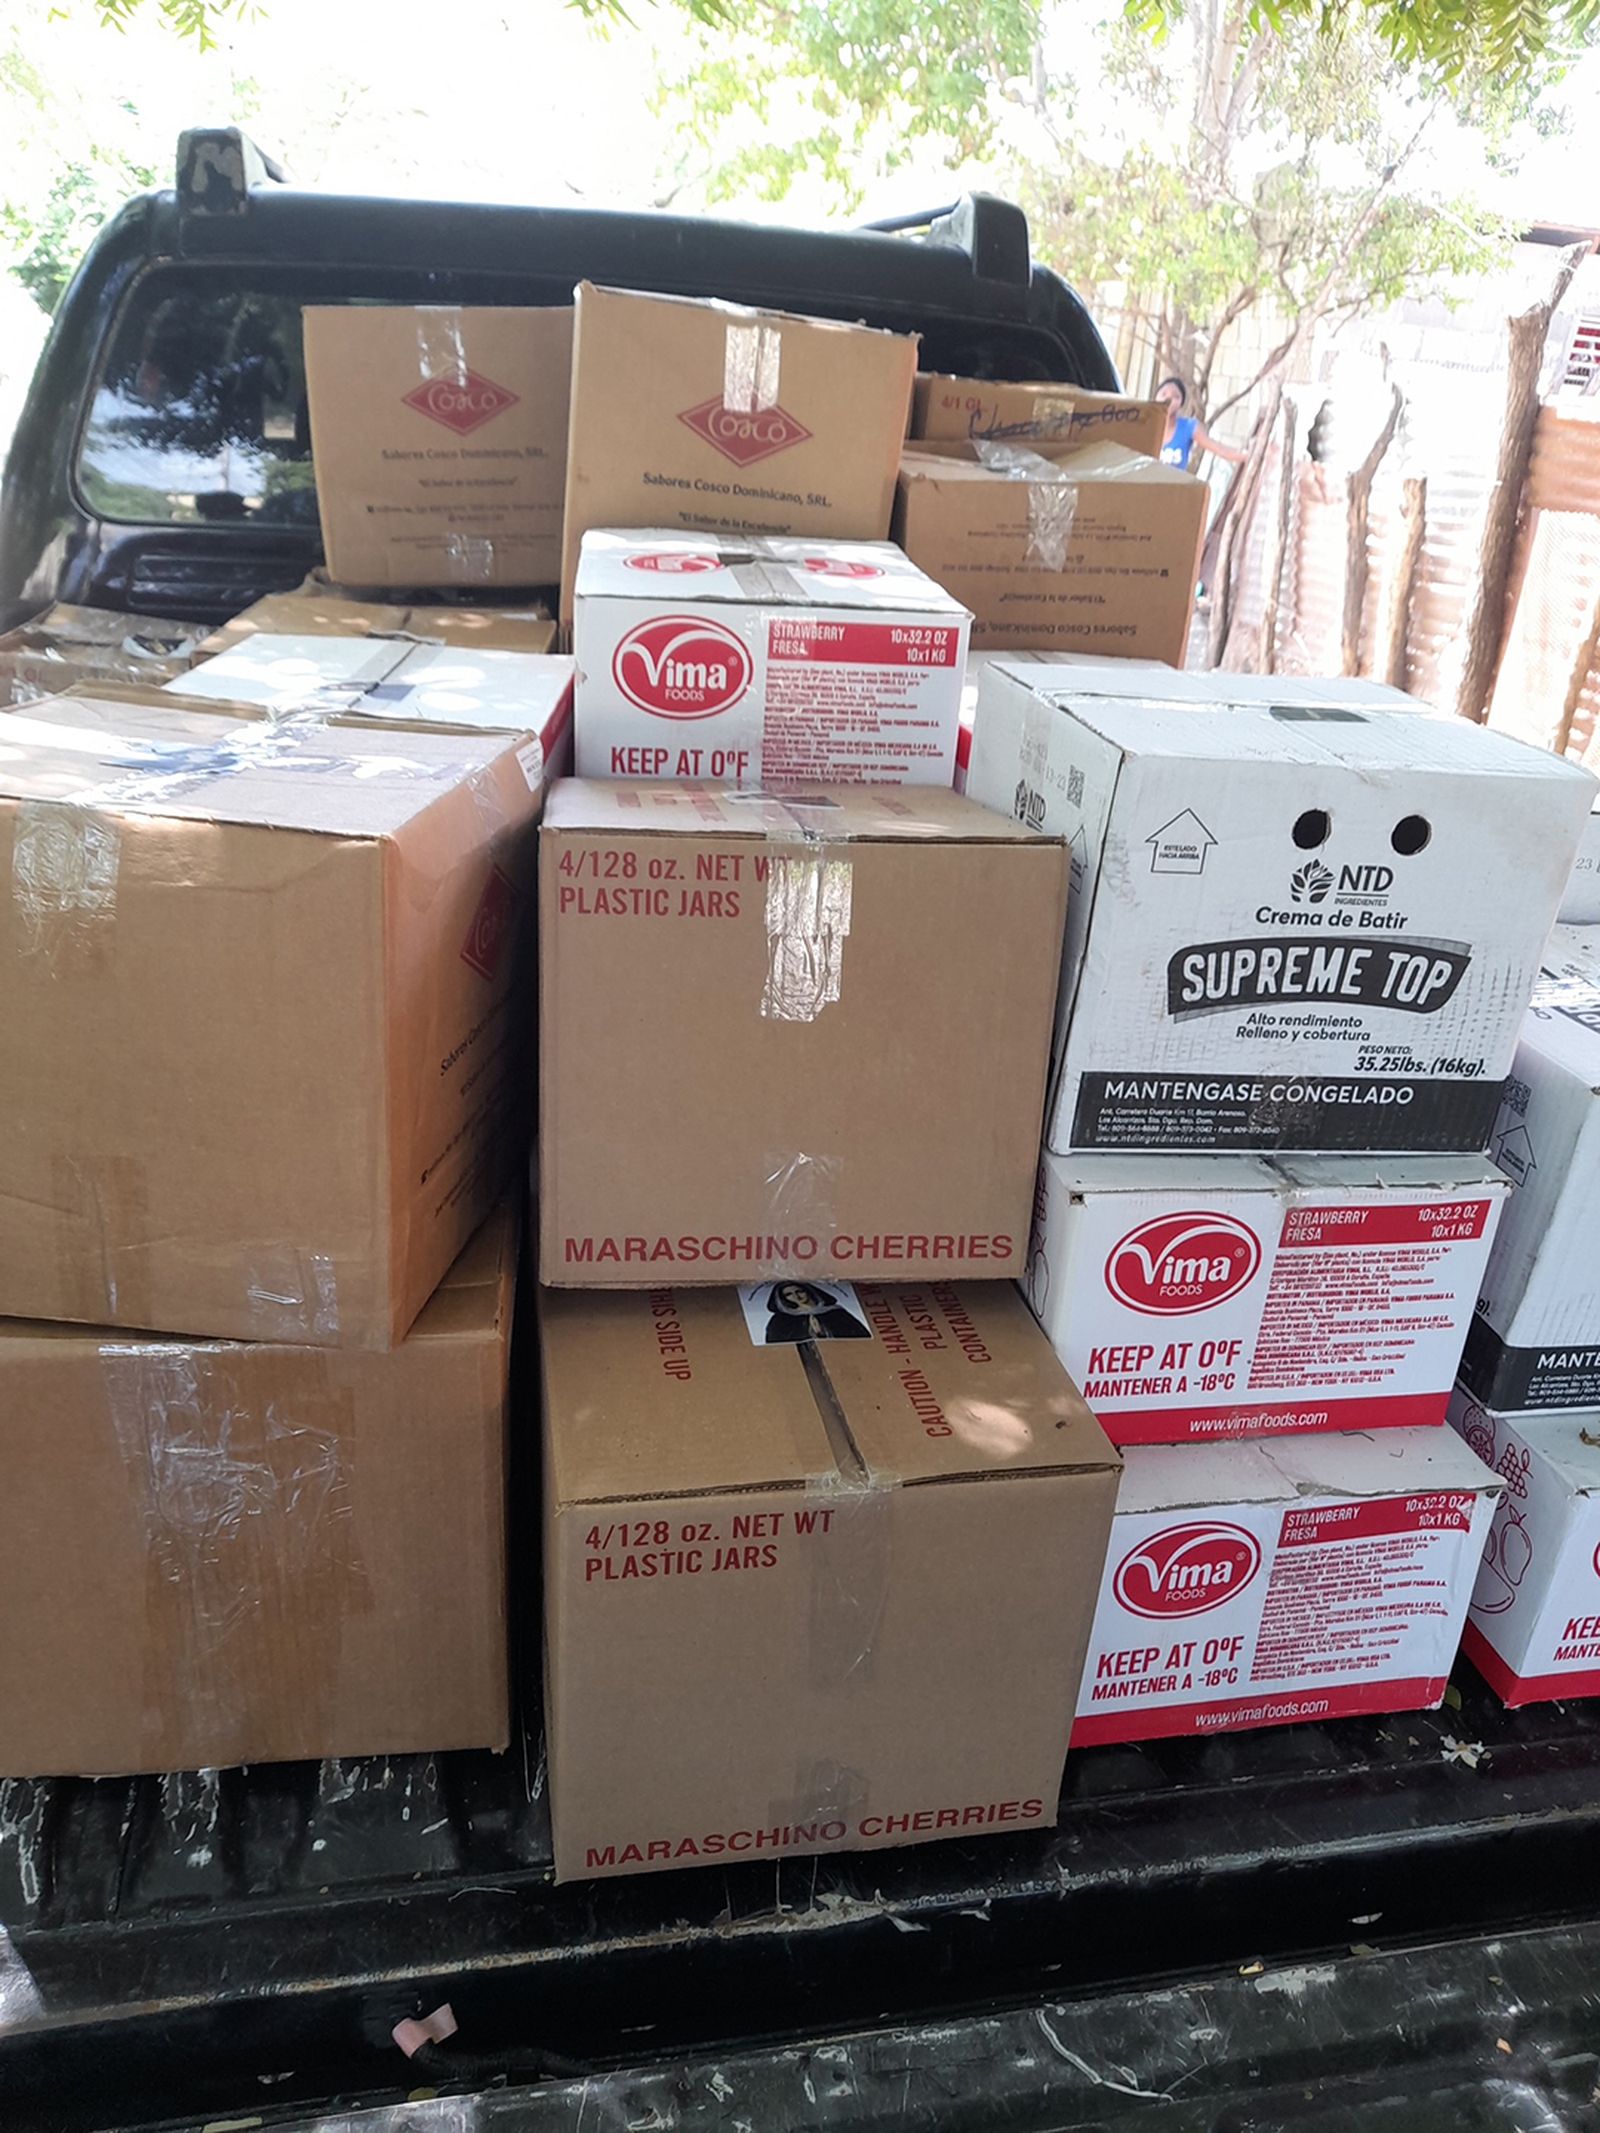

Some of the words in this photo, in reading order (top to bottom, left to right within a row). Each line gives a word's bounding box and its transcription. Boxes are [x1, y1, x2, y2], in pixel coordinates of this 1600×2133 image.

[643, 471, 691, 489] Sabores
[694, 478, 731, 495] Cosco
[733, 484, 804, 505] Dominicano,
[807, 493, 832, 508] SRL.
[773, 625, 845, 641] STRAWBERRY
[891, 629, 931, 645] 10x32.2
[933, 630, 948, 645] OZ
[624, 627, 727, 690] Vima
[773, 640, 808, 655] FRESA
[906, 648, 930, 662] 10x1
[932, 649, 946, 663] KG
[665, 688, 705, 702] FOODS
[611, 747, 668, 775] KEEP
[677, 749, 703, 776] AT
[559, 850, 638, 880] 4/128
[648, 858, 686, 881] oz.
[696, 853, 745, 882] NET
[1338, 864, 1394, 892] NTD
[559, 886, 669, 917] PLASTIC
[677, 890, 740, 918] JARS
[1255, 906, 1323, 928] Crema
[1327, 907, 1354, 928] de
[1359, 911, 1409, 931] Batir
[1181, 946, 1374, 1003] SUPREME
[1381, 951, 1454, 1006] TOP
[1236, 1026, 1289, 1040] Relleno
[1291, 1030, 1300, 1042] y
[1302, 1027, 1371, 1042] cobertura
[1246, 1013, 1276, 1028] Alto
[1278, 1014, 1363, 1029] rendimiento
[1358, 1045, 1381, 1055] PESO
[1353, 1056, 1427, 1075] 35.25lbs.
[1430, 1056, 1486, 1077] (16kg).
[1104, 1081, 1263, 1102] MANTENGASE
[1269, 1084, 1414, 1106] CONGELADO
[1289, 1210, 1369, 1227] STRAWBERRY
[1417, 1207, 1461, 1223] 10x32.2
[1463, 1205, 1479, 1220] OZ
[1286, 1226, 1322, 1242] FRESA
[1431, 1223, 1457, 1239] 10x1
[1457, 1222, 1474, 1238] KG
[564, 1236, 819, 1263] MARASCHINO
[829, 1234, 1014, 1260] CHERRIES
[1119, 1224, 1230, 1286] Vima
[1159, 1283, 1203, 1298] FOODS
[864, 1299, 912, 1354] HANDLE
[899, 1294, 947, 1351] PLASTIC
[655, 1320, 686, 1356] SIDE
[663, 1359, 691, 1381] UP
[1088, 1344, 1154, 1374] KEEP
[1159, 1342, 1192, 1371] AT
[1083, 1377, 1172, 1399] MANTENER
[1176, 1376, 1188, 1393] A
[897, 1369, 952, 1437] CAUTION
[1189, 1410, 1328, 1433] www.vimafoods.com
[1287, 1506, 1360, 1528] STRAWBERRY
[1449, 1495, 1466, 1510] OZ
[585, 1520, 670, 1551] 4/128
[680, 1520, 721, 1545] oz.
[732, 1511, 786, 1541] NET
[793, 1508, 836, 1537] WT
[1284, 1526, 1318, 1542] FRESA
[1417, 1513, 1442, 1528] 10x1
[1443, 1511, 1461, 1526] KG
[585, 1548, 703, 1583] PLASTIC
[711, 1542, 778, 1574] JARS
[1127, 1533, 1230, 1593] Vima
[1164, 1586, 1207, 1602] FOODS
[1097, 1645, 1163, 1679] KEEP
[1165, 1641, 1197, 1670] AT
[1091, 1676, 1177, 1701] MANTENER
[1181, 1674, 1192, 1690] A
[1195, 1698, 1329, 1727] www.vimafoods.com
[586, 1819, 846, 1870] MARASCHINO
[859, 1798, 1044, 1839] CHERRIES
